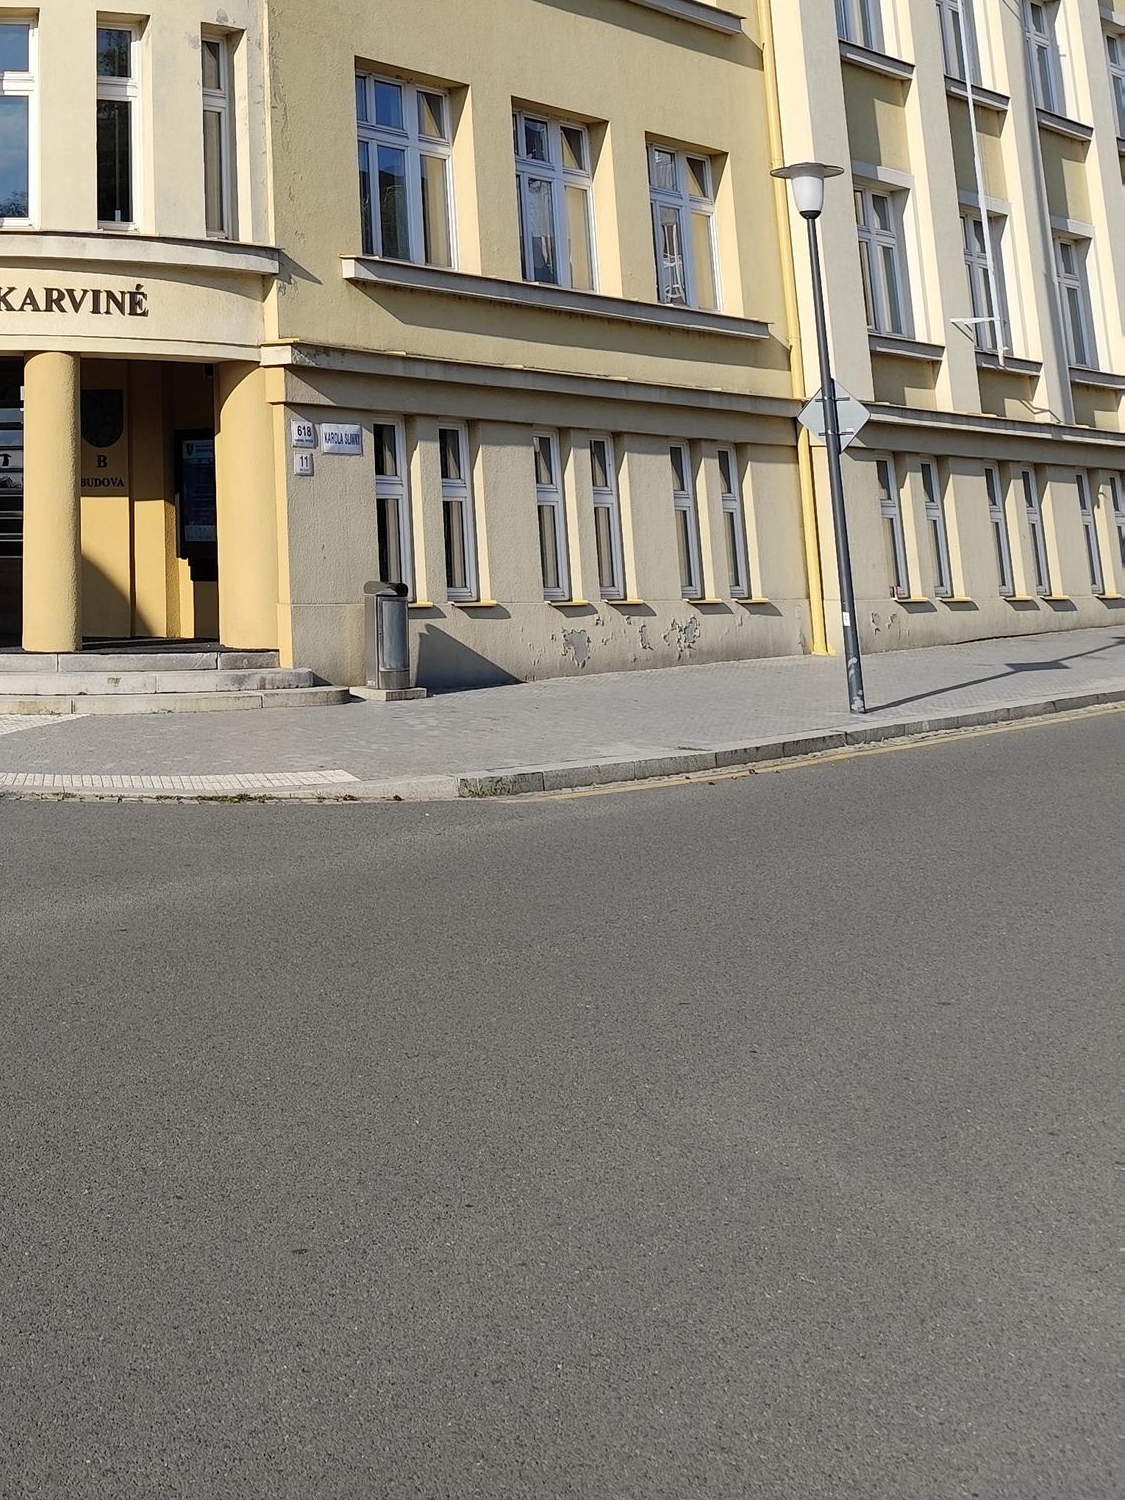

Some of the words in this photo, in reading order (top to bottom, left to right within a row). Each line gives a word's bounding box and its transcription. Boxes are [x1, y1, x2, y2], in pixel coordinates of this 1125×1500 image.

[297, 425, 312, 437] 618
[96, 454, 108, 468] B
[299, 455, 309, 468] 11
[80, 477, 125, 488] BUDOVA
